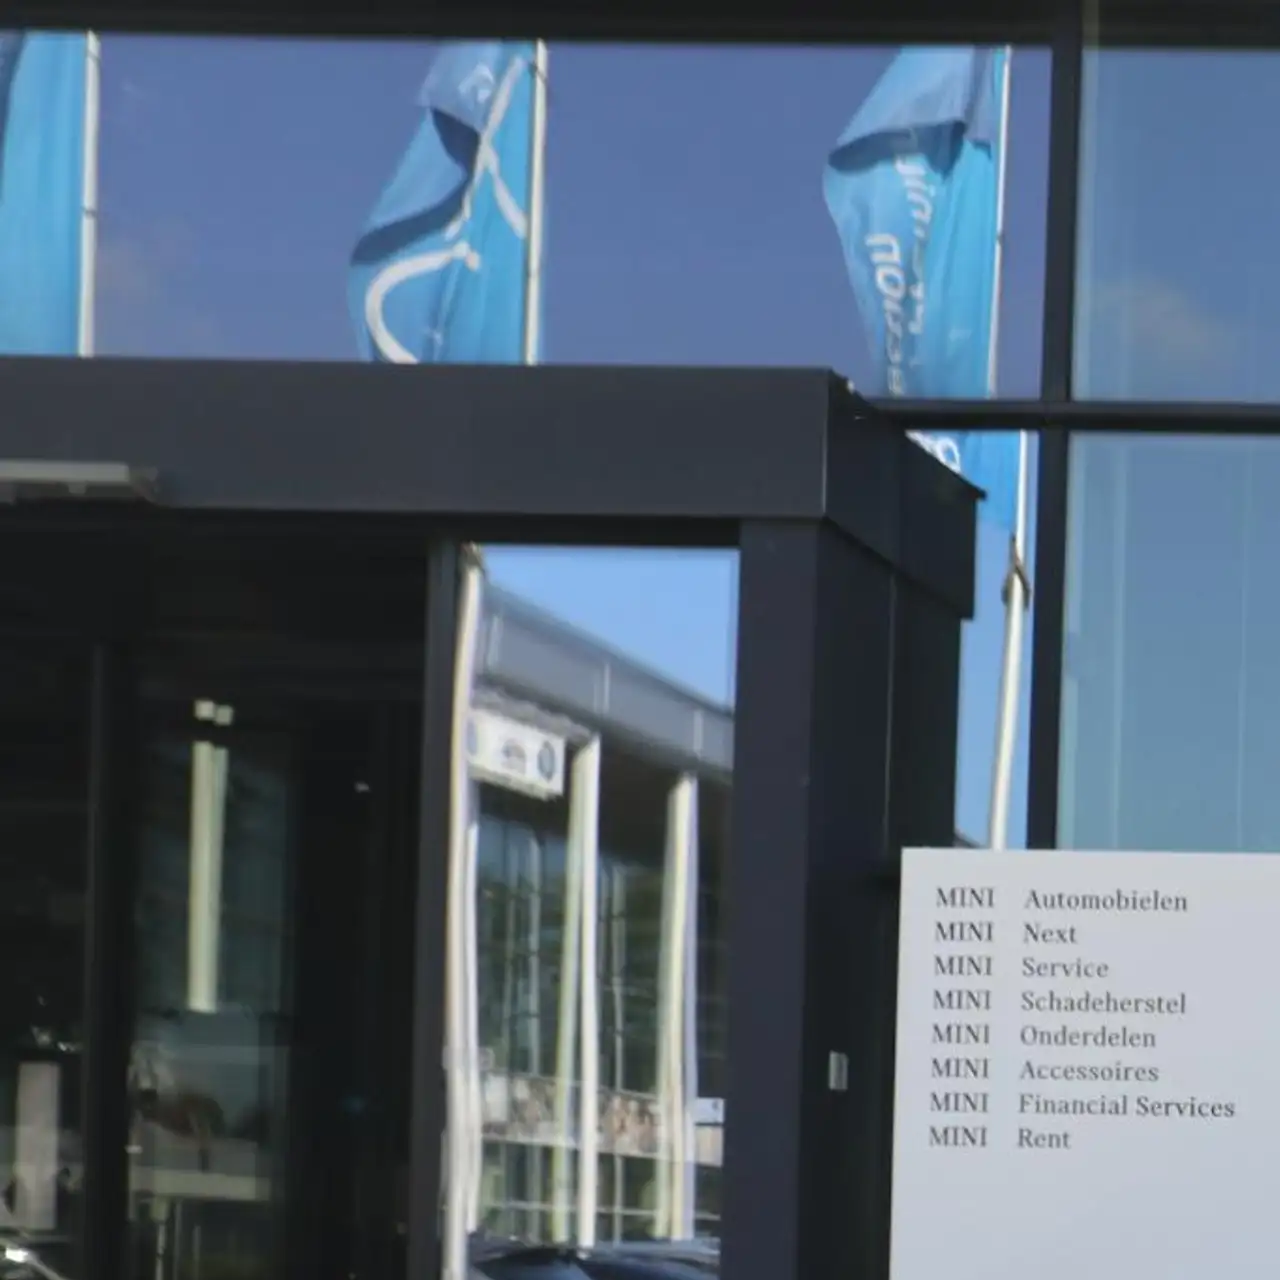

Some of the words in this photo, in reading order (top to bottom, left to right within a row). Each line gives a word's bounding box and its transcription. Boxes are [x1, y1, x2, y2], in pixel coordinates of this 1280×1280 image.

[936, 886, 994, 909] MINI
[1025, 888, 1188, 912] Automobielen
[935, 920, 993, 943] MINI
[1023, 922, 1077, 944] Next
[934, 955, 992, 977] MINI
[1022, 957, 1109, 979] Service
[933, 989, 991, 1011] MINI
[1020, 989, 1186, 1015] Schadeherstel
[932, 1023, 990, 1045] MINI
[1019, 1024, 1156, 1048] Onderdelen
[931, 1056, 989, 1080] MINI
[1020, 1060, 1159, 1082] Accessoires
[930, 1091, 989, 1114] MINI
[1019, 1093, 1129, 1116] Financial
[1135, 1095, 1236, 1119] Services
[929, 1125, 988, 1148] MINI
[1017, 1127, 1070, 1149] Rent
